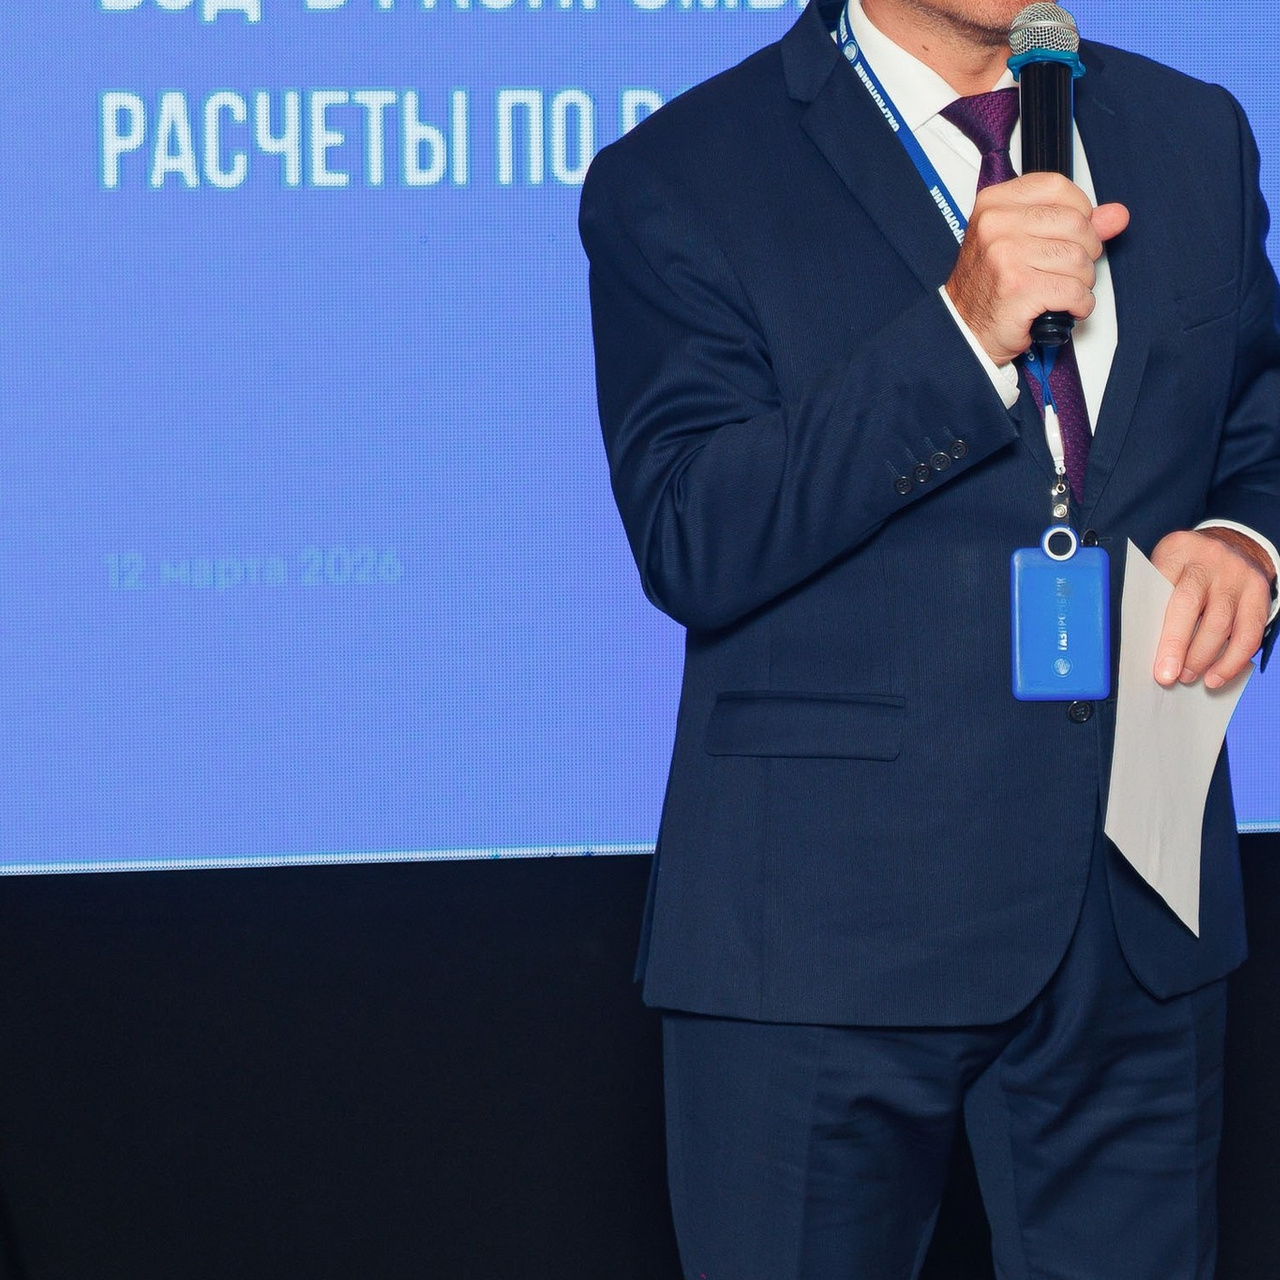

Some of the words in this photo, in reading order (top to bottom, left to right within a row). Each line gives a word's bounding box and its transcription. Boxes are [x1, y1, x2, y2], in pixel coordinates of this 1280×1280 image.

[103, 90, 467, 189] РАСЧЕТЫ
[497, 89, 594, 186] ПО
[930, 185, 965, 246] ПРОМБАНК
